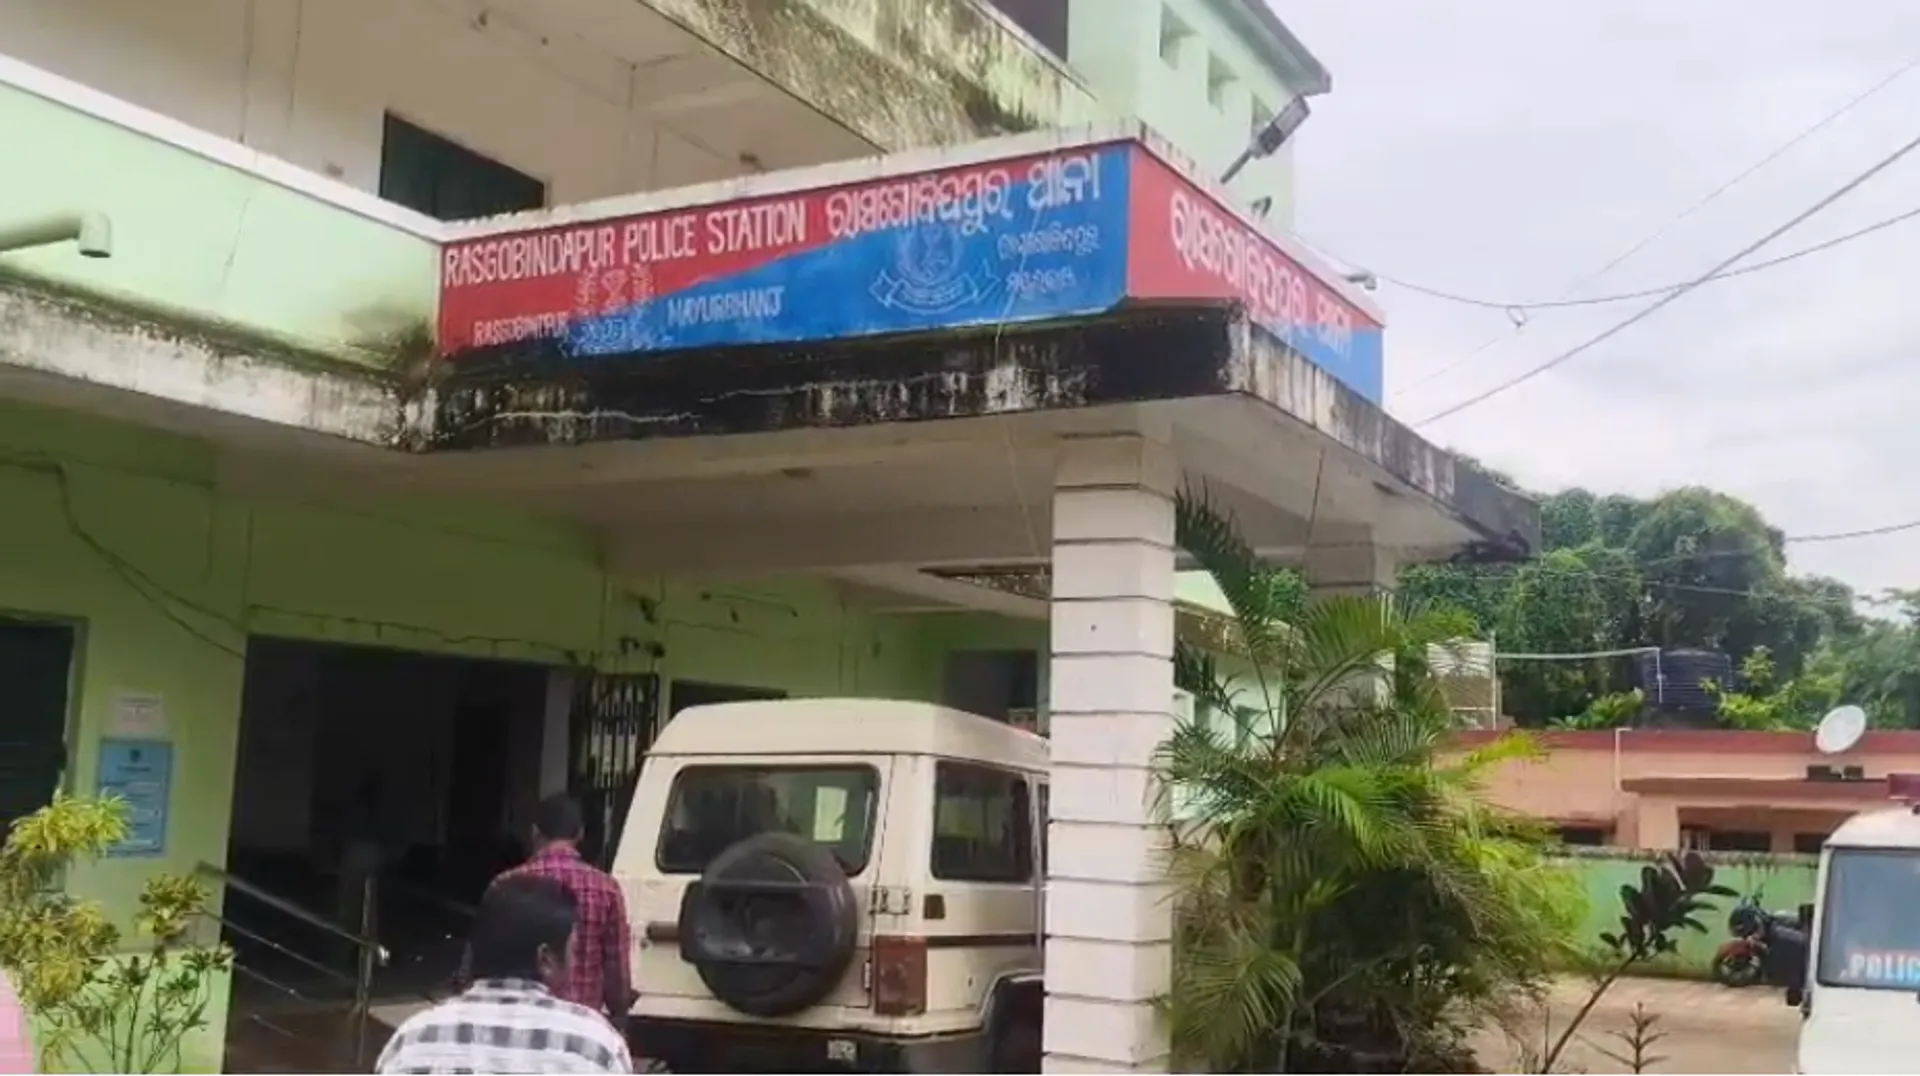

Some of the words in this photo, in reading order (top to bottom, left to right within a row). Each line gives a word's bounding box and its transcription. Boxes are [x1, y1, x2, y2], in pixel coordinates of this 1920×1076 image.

[1026, 153, 1100, 211] ଥାନା
[444, 226, 615, 288] RASGOBINDAPUR
[623, 214, 698, 265] POLICE
[706, 200, 806, 255] STATION
